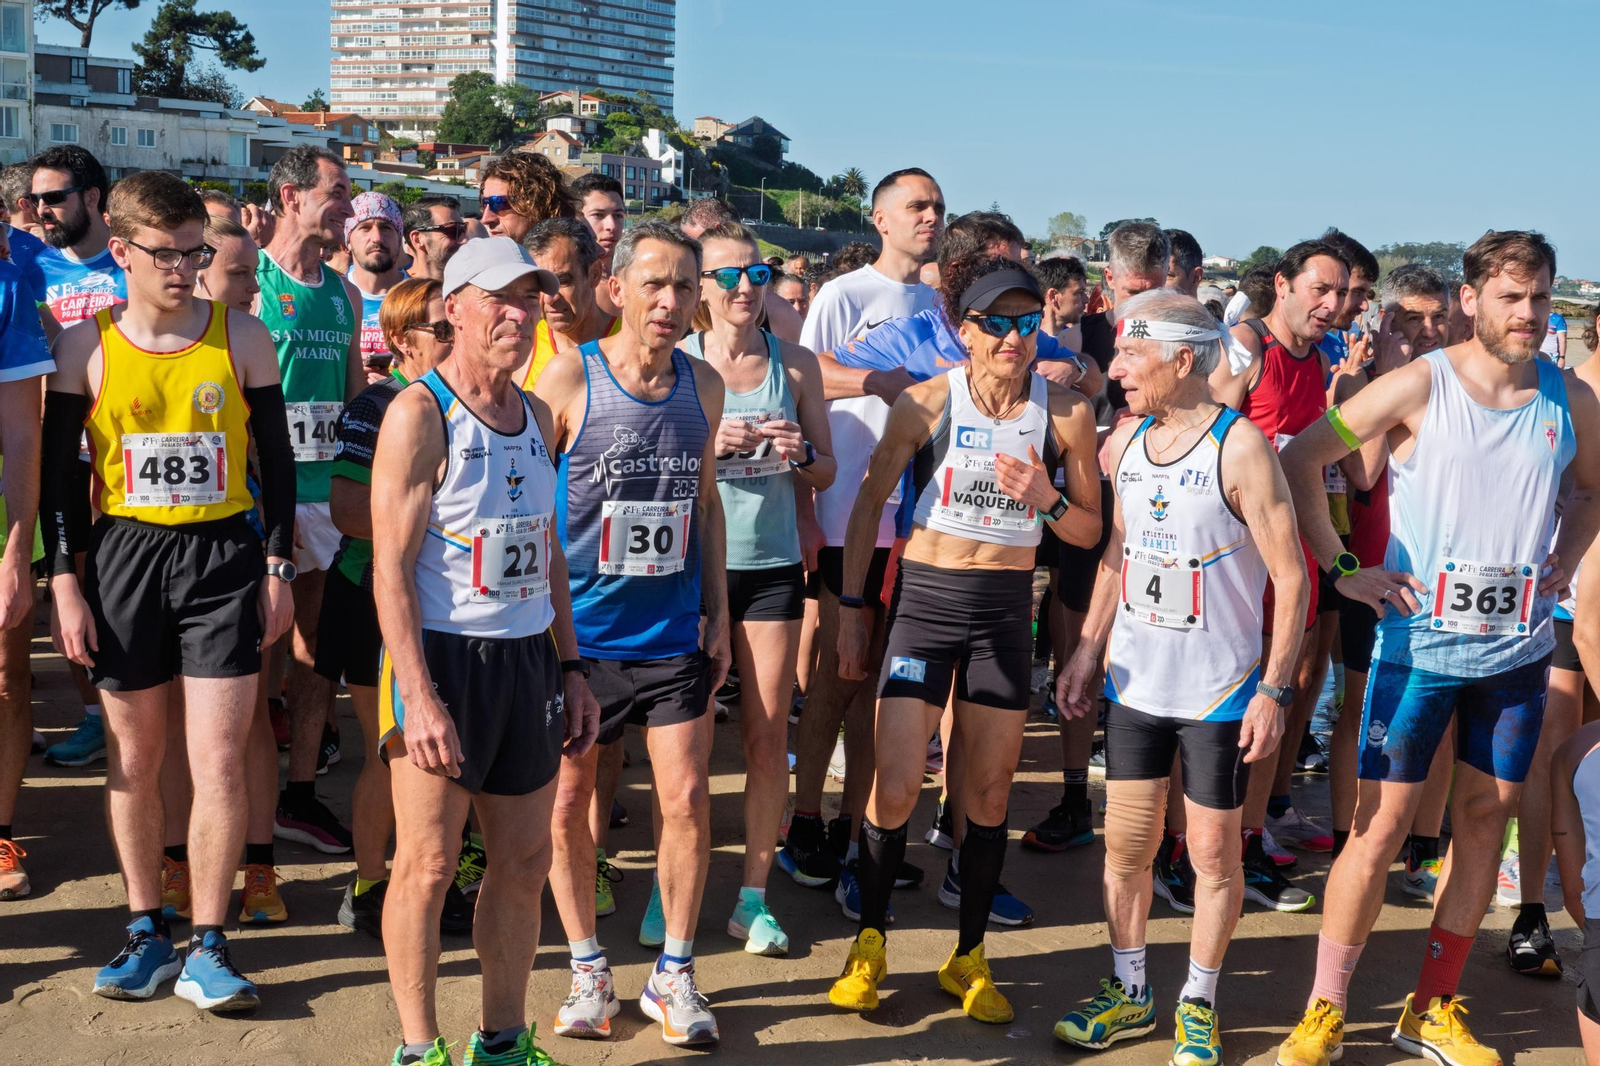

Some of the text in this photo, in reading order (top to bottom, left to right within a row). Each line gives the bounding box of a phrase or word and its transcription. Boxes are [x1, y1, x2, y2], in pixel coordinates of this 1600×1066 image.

[61, 295, 114, 311] CARREIRA
[62, 308, 82, 319] PRAIA
[84, 308, 92, 316] DE
[272, 329, 304, 342] SAN
[295, 345, 341, 361] MARÍN
[293, 420, 337, 444] 140
[139, 455, 210, 485] 483
[970, 480, 1005, 495] JUL
[1186, 485, 1214, 496] seguros
[642, 505, 669, 513] CARREIRA
[953, 491, 1027, 512] VAQUERO
[628, 524, 674, 555] 30
[1142, 530, 1177, 540] ATLETISMO
[1142, 537, 1177, 551] SAMIL
[503, 541, 538, 578] 22
[1479, 565, 1506, 573] CARREIRA
[1145, 574, 1162, 604] 4
[1450, 582, 1517, 615] 363
